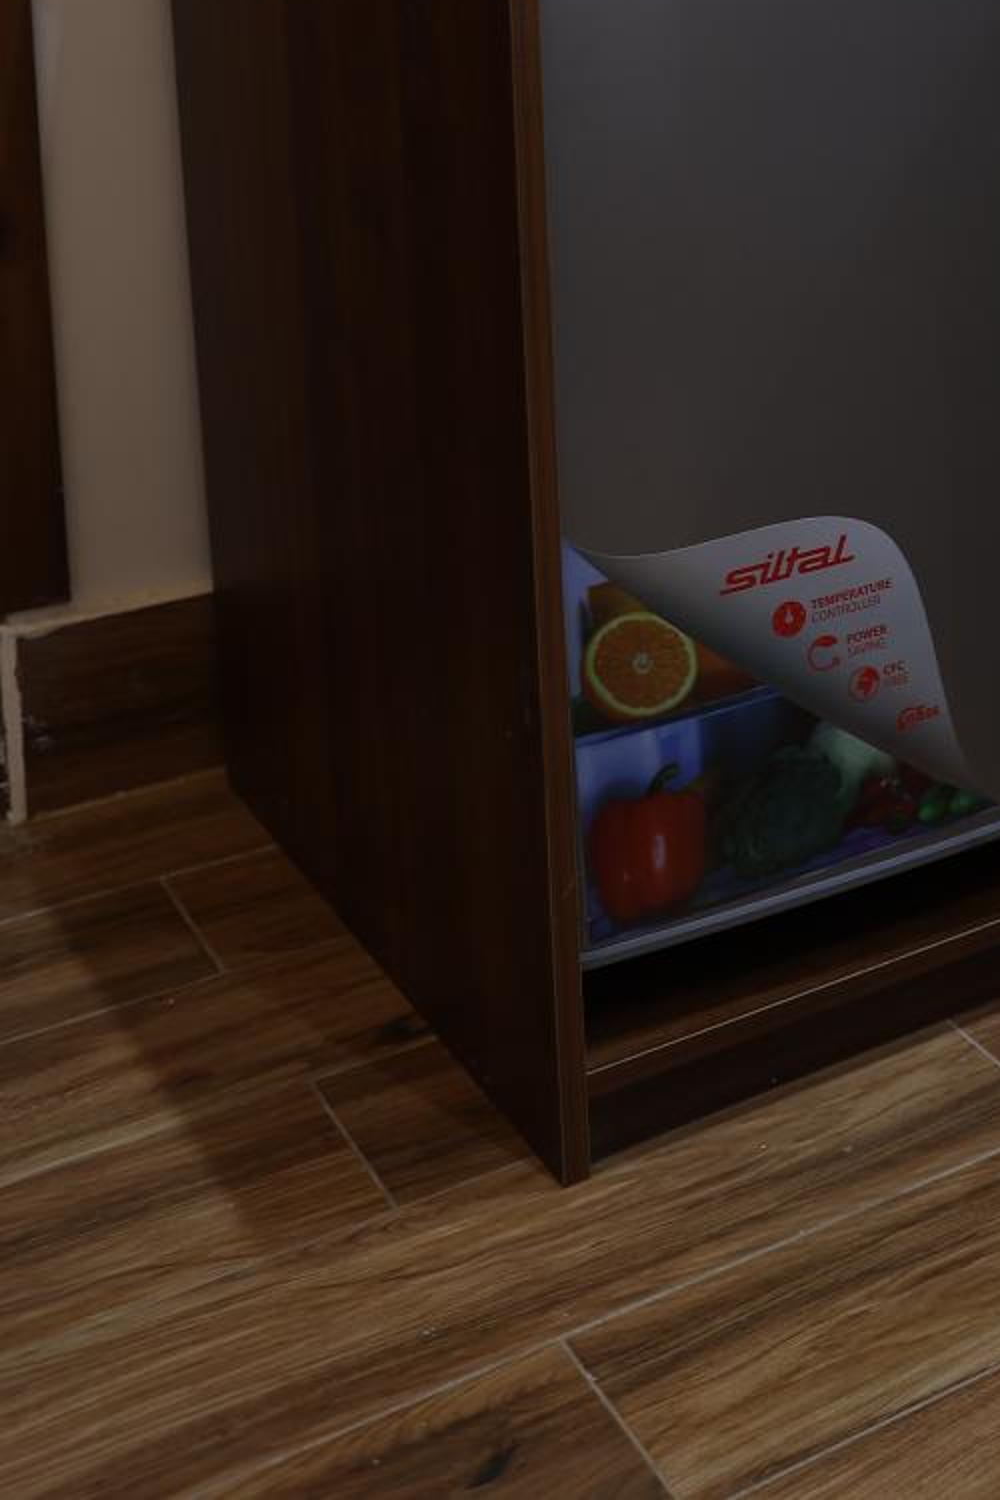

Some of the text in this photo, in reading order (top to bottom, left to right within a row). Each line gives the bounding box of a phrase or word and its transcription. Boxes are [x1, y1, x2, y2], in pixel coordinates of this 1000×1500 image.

[811, 578, 893, 610] TEMPERATURE
[811, 595, 881, 624] CONTROLLER
[847, 625, 887, 644] POWER
